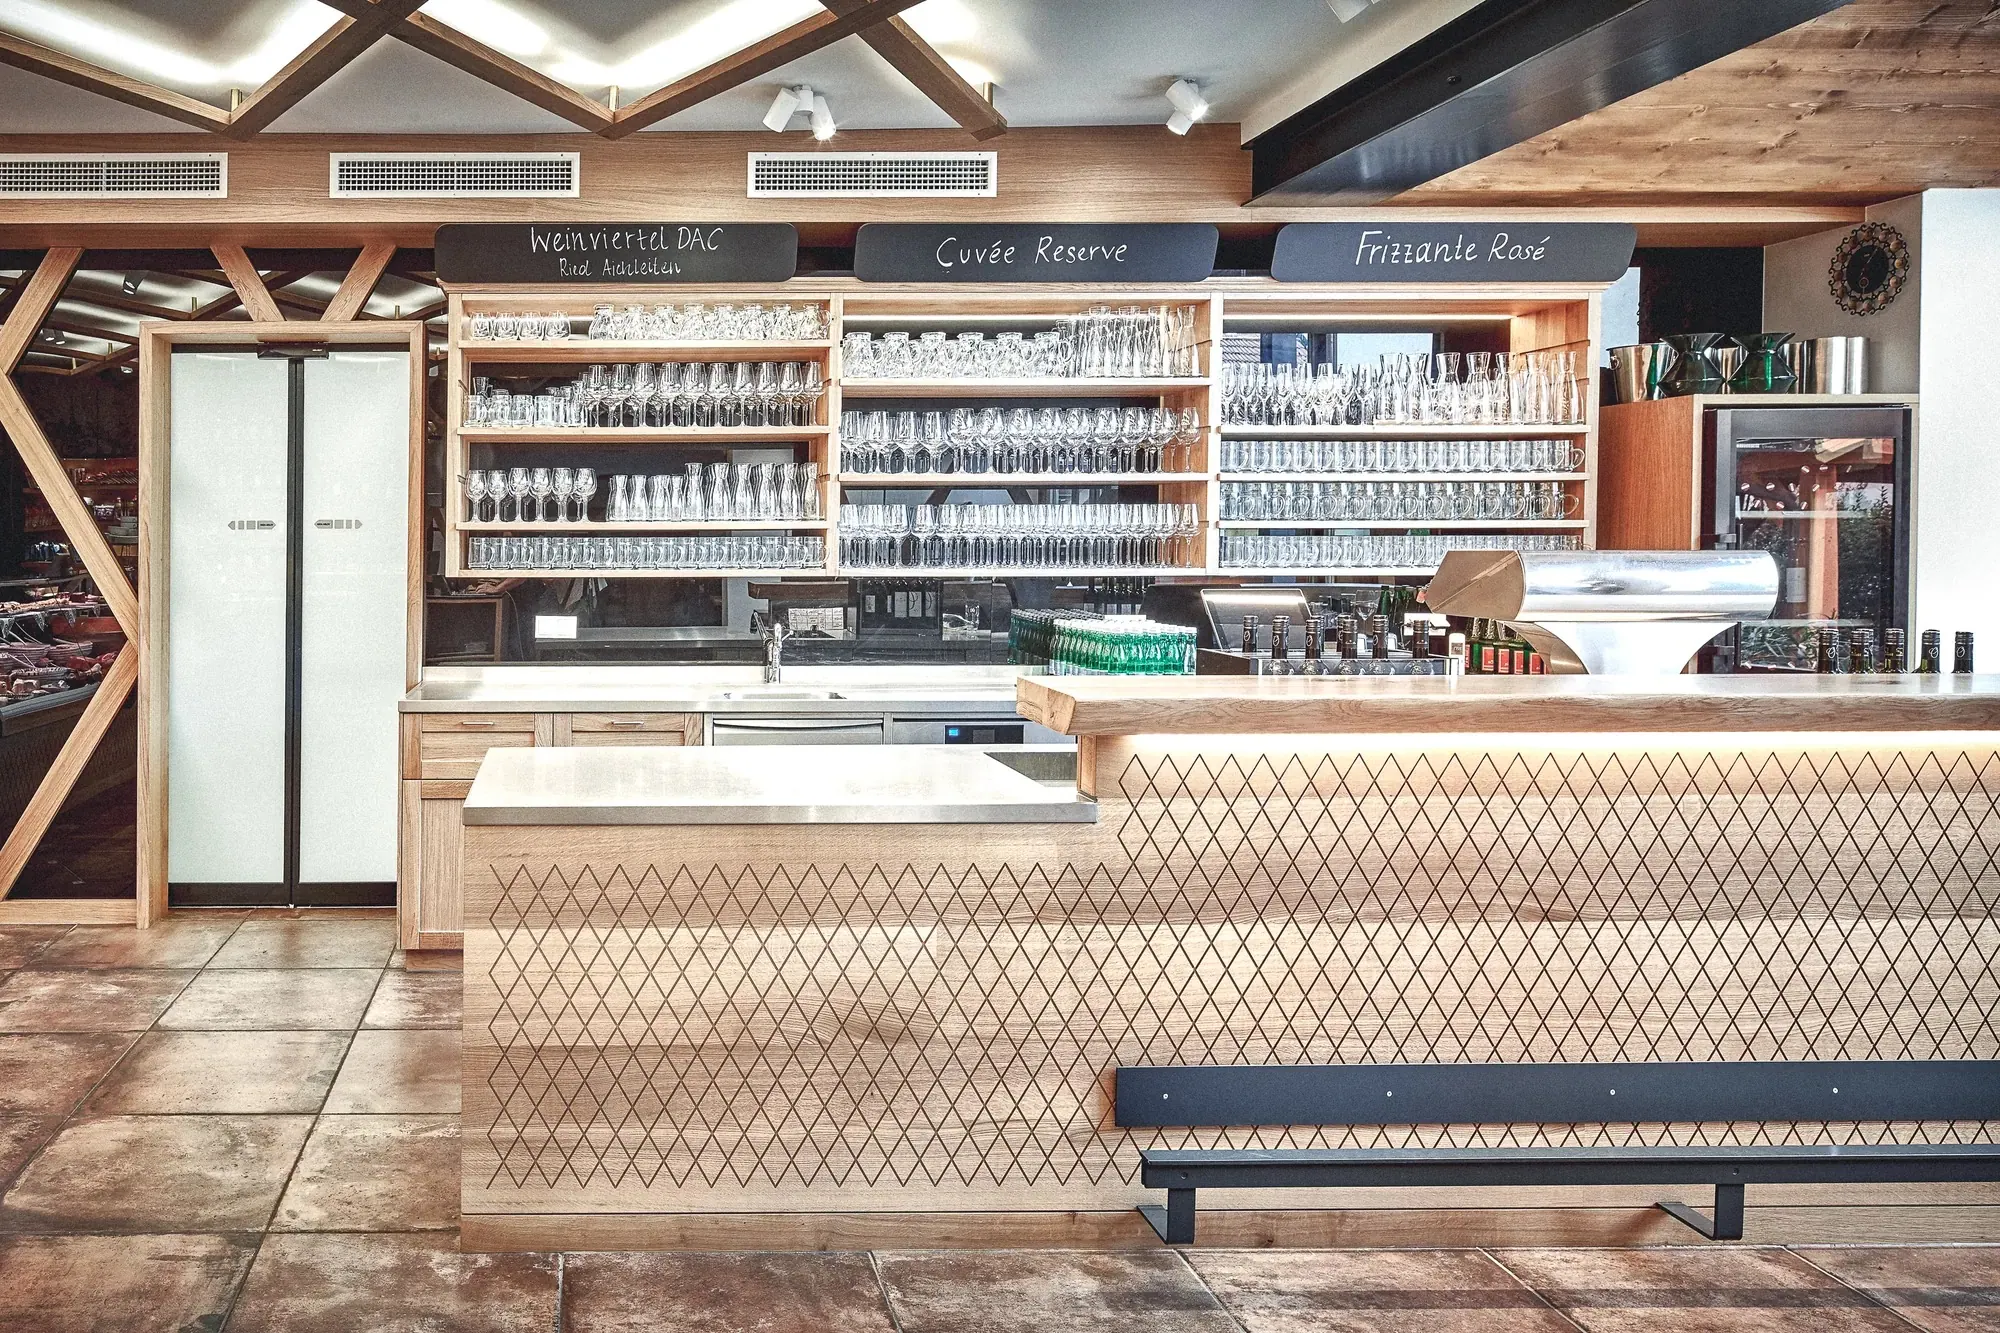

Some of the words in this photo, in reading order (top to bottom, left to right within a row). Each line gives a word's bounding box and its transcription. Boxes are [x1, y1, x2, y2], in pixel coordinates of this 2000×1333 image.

[531, 226, 669, 253] Weinviertel
[677, 226, 724, 252] DAC
[937, 237, 1015, 267] Cuvée
[1035, 236, 1128, 263] Reserve
[1355, 230, 1478, 265] Frizzante
[1488, 232, 1551, 261] Rosé
[559, 257, 592, 277] Ried
[602, 257, 682, 277] Aichleiten
